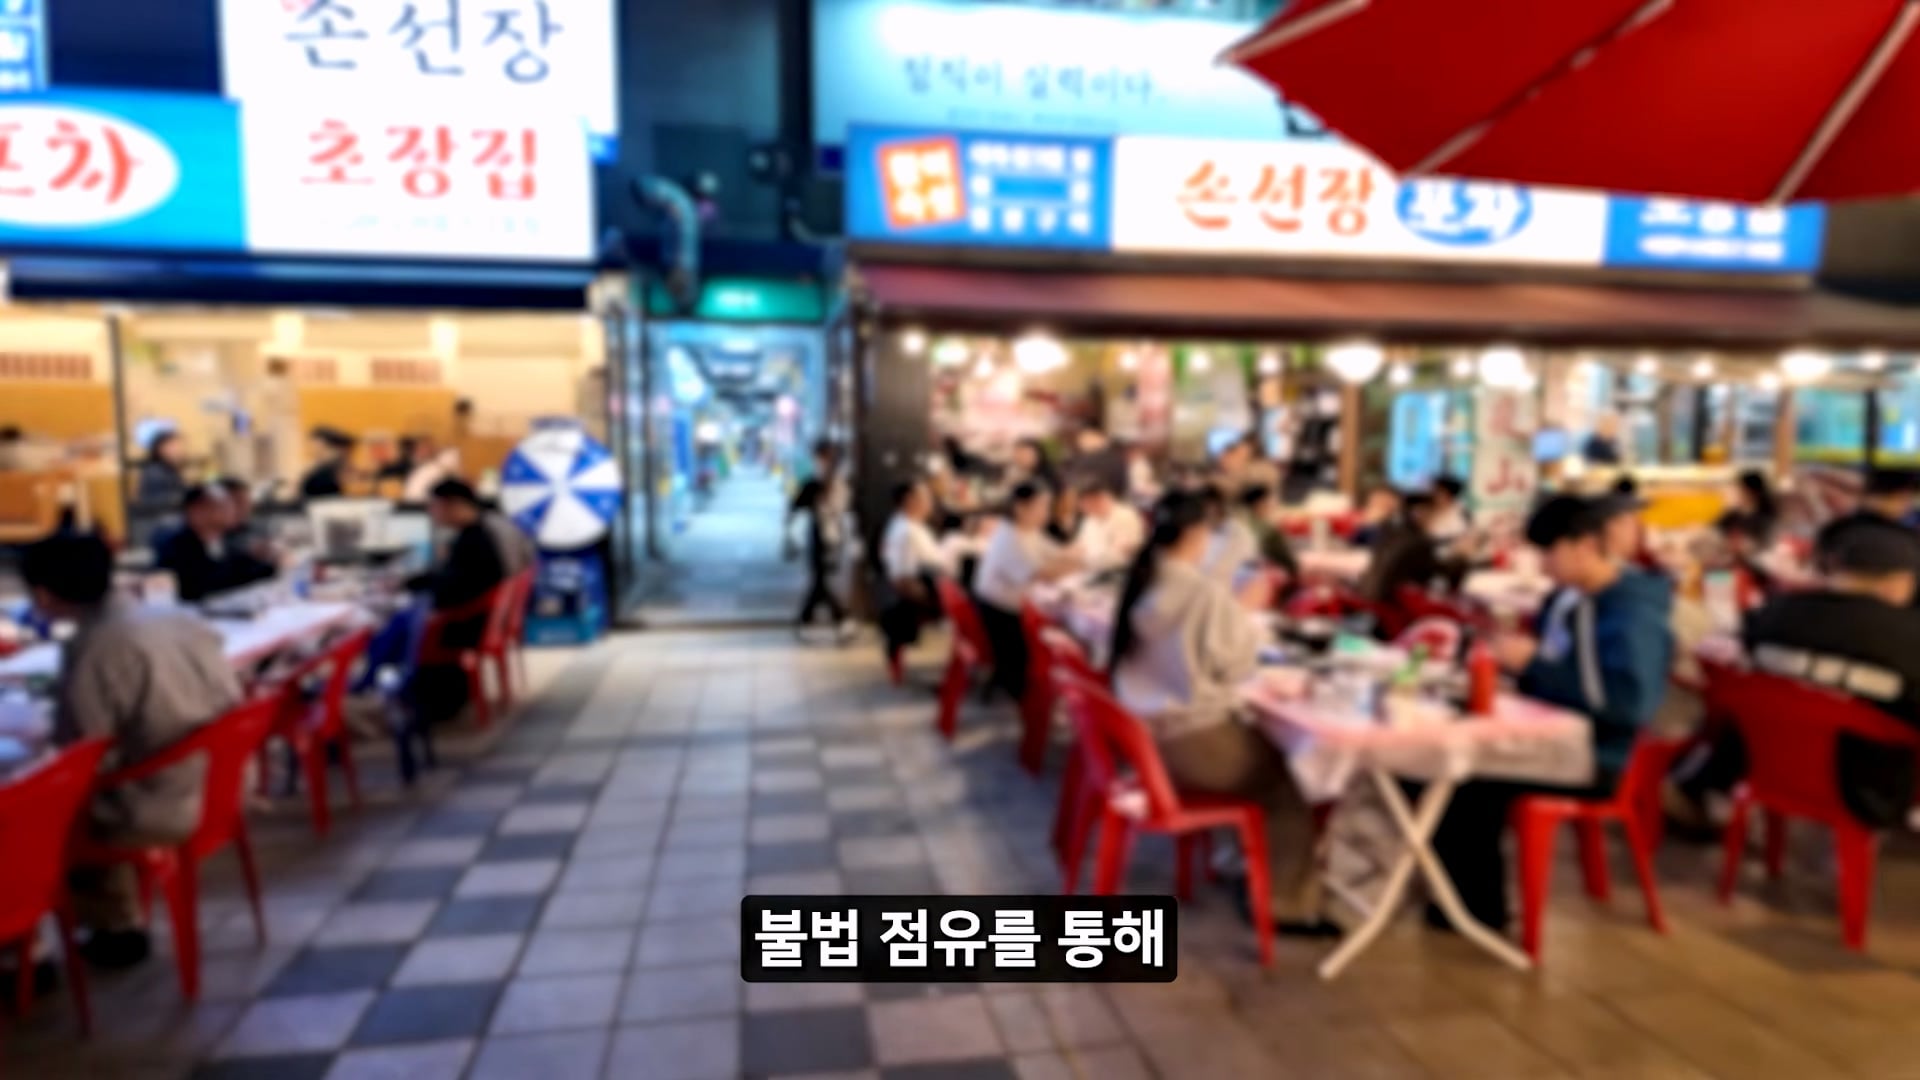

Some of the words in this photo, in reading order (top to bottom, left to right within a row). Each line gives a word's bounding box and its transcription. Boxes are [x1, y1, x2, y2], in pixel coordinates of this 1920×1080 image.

[284, 0, 565, 84] 손선장
[299, 117, 538, 202] 초장집
[1176, 161, 1374, 238] 손선장
